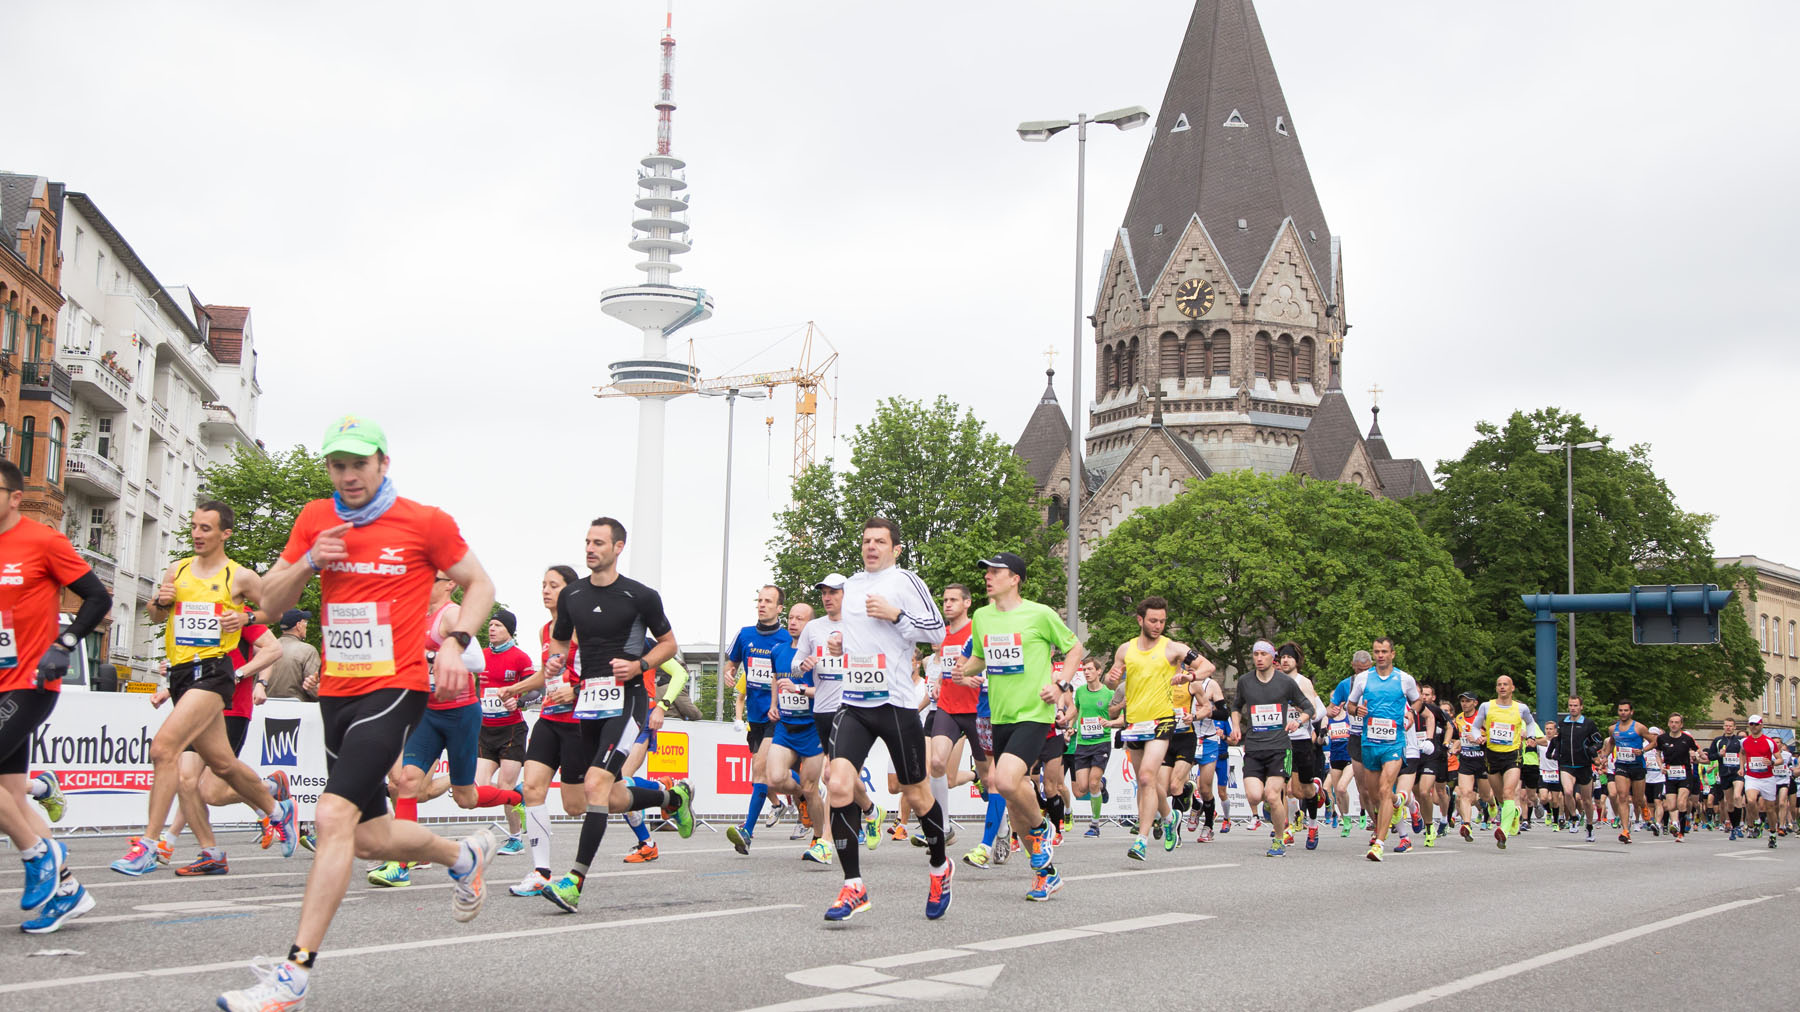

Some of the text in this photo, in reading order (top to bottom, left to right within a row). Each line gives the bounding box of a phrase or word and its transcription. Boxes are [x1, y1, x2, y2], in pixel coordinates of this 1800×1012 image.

[179, 617, 218, 630] 1352
[328, 630, 384, 649] 22601 1
[988, 647, 1020, 659] 1045
[847, 671, 884, 683] 1920
[584, 688, 620, 702] 1199
[781, 696, 806, 705] 1195
[1255, 713, 1280, 722] 1147
[1370, 727, 1394, 735] 1296
[1492, 729, 1512, 738] 1521
[661, 745, 685, 755] LOTTO
[726, 757, 752, 782] TI
[60, 773, 154, 786] KOHOLFRE
